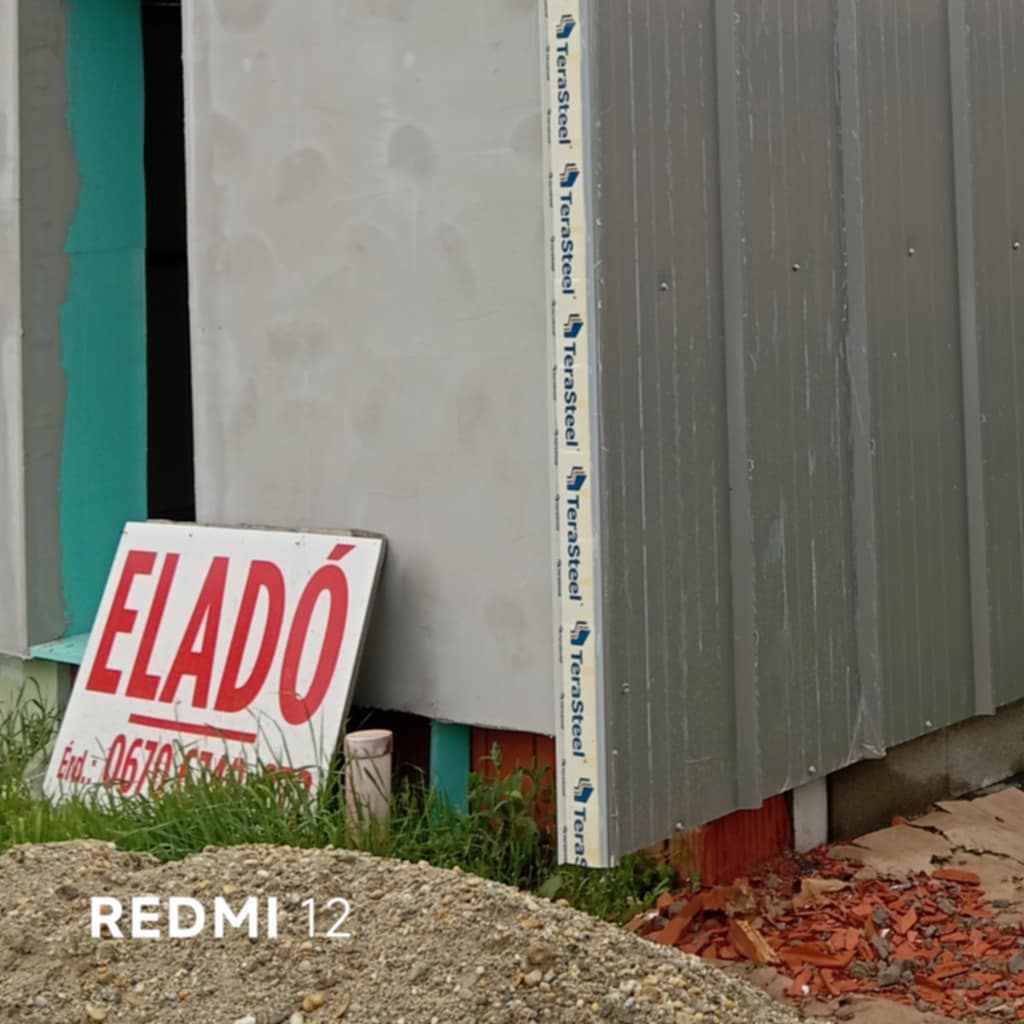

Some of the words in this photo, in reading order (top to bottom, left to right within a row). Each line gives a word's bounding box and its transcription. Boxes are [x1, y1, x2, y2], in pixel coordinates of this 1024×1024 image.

[556, 42, 572, 145] TeraSteel
[560, 191, 576, 295] TeraSteel
[563, 342, 579, 447] TeraSteel
[566, 495, 583, 601] TeraSteel
[85, 543, 357, 725] ELADÓ
[570, 649, 586, 758] TeraSteel
